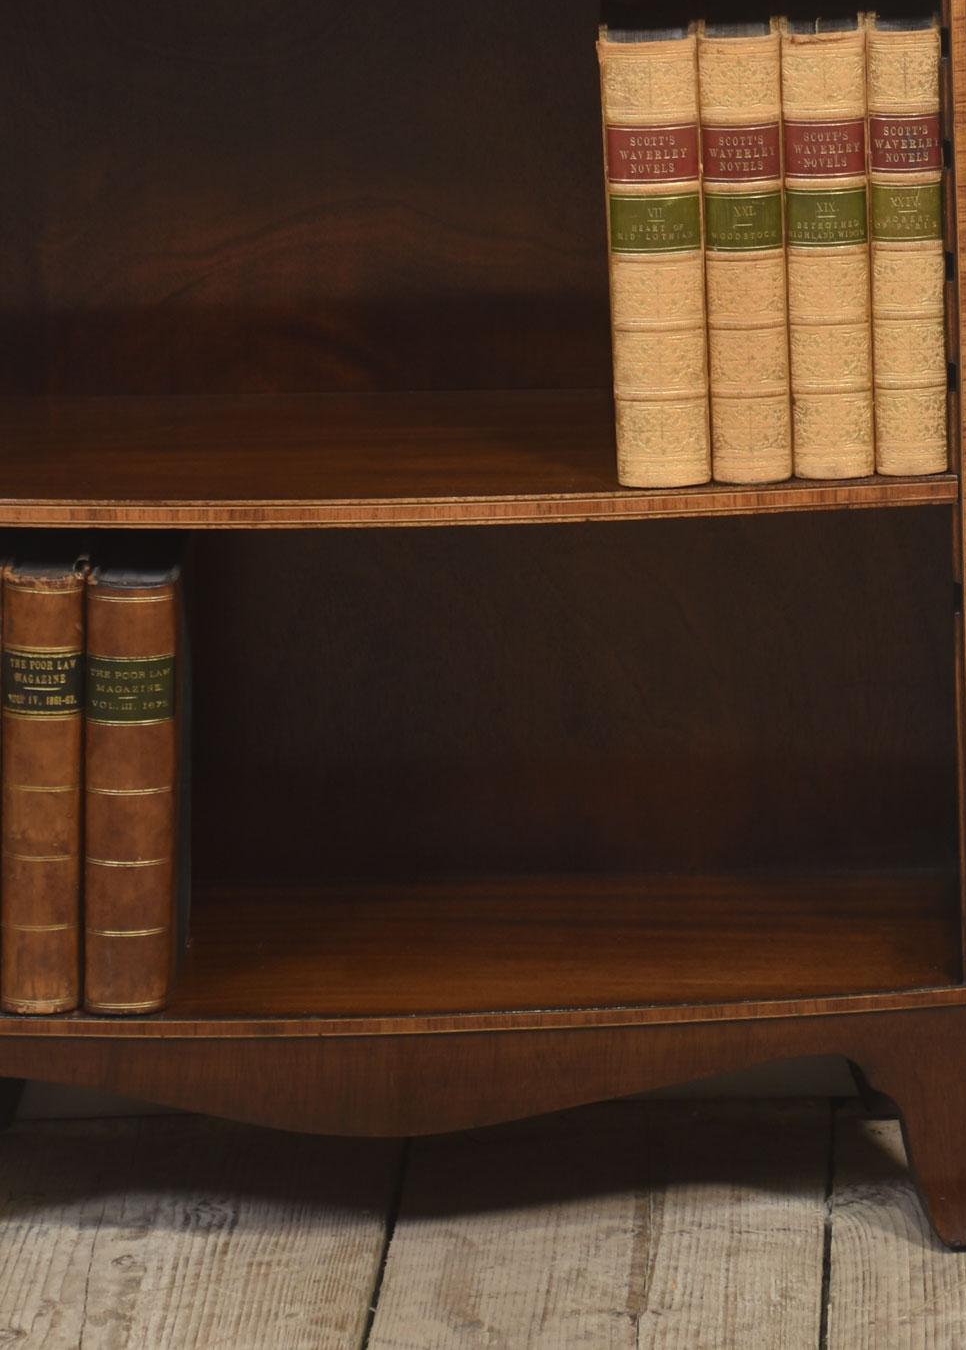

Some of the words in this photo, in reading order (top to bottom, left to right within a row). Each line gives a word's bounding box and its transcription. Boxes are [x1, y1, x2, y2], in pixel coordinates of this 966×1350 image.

[803, 130, 848, 141] SCOTT'S
[883, 125, 928, 136] SCOTT'S
[630, 135, 675, 146] SCOTT'S
[719, 135, 763, 146] SCOTT'S
[708, 146, 775, 158] WAVERLEY
[793, 142, 860, 154] WAVERLEY
[619, 148, 688, 160] WAVERLEY
[886, 152, 928, 162] NOVELS
[630, 163, 674, 173] NOVELS
[720, 161, 763, 171] NOVELS
[804, 157, 847, 168] NOVELS
[30, 660, 53, 670] POOR
[57, 659, 76, 669] LAW
[115, 671, 146, 680] POOR
